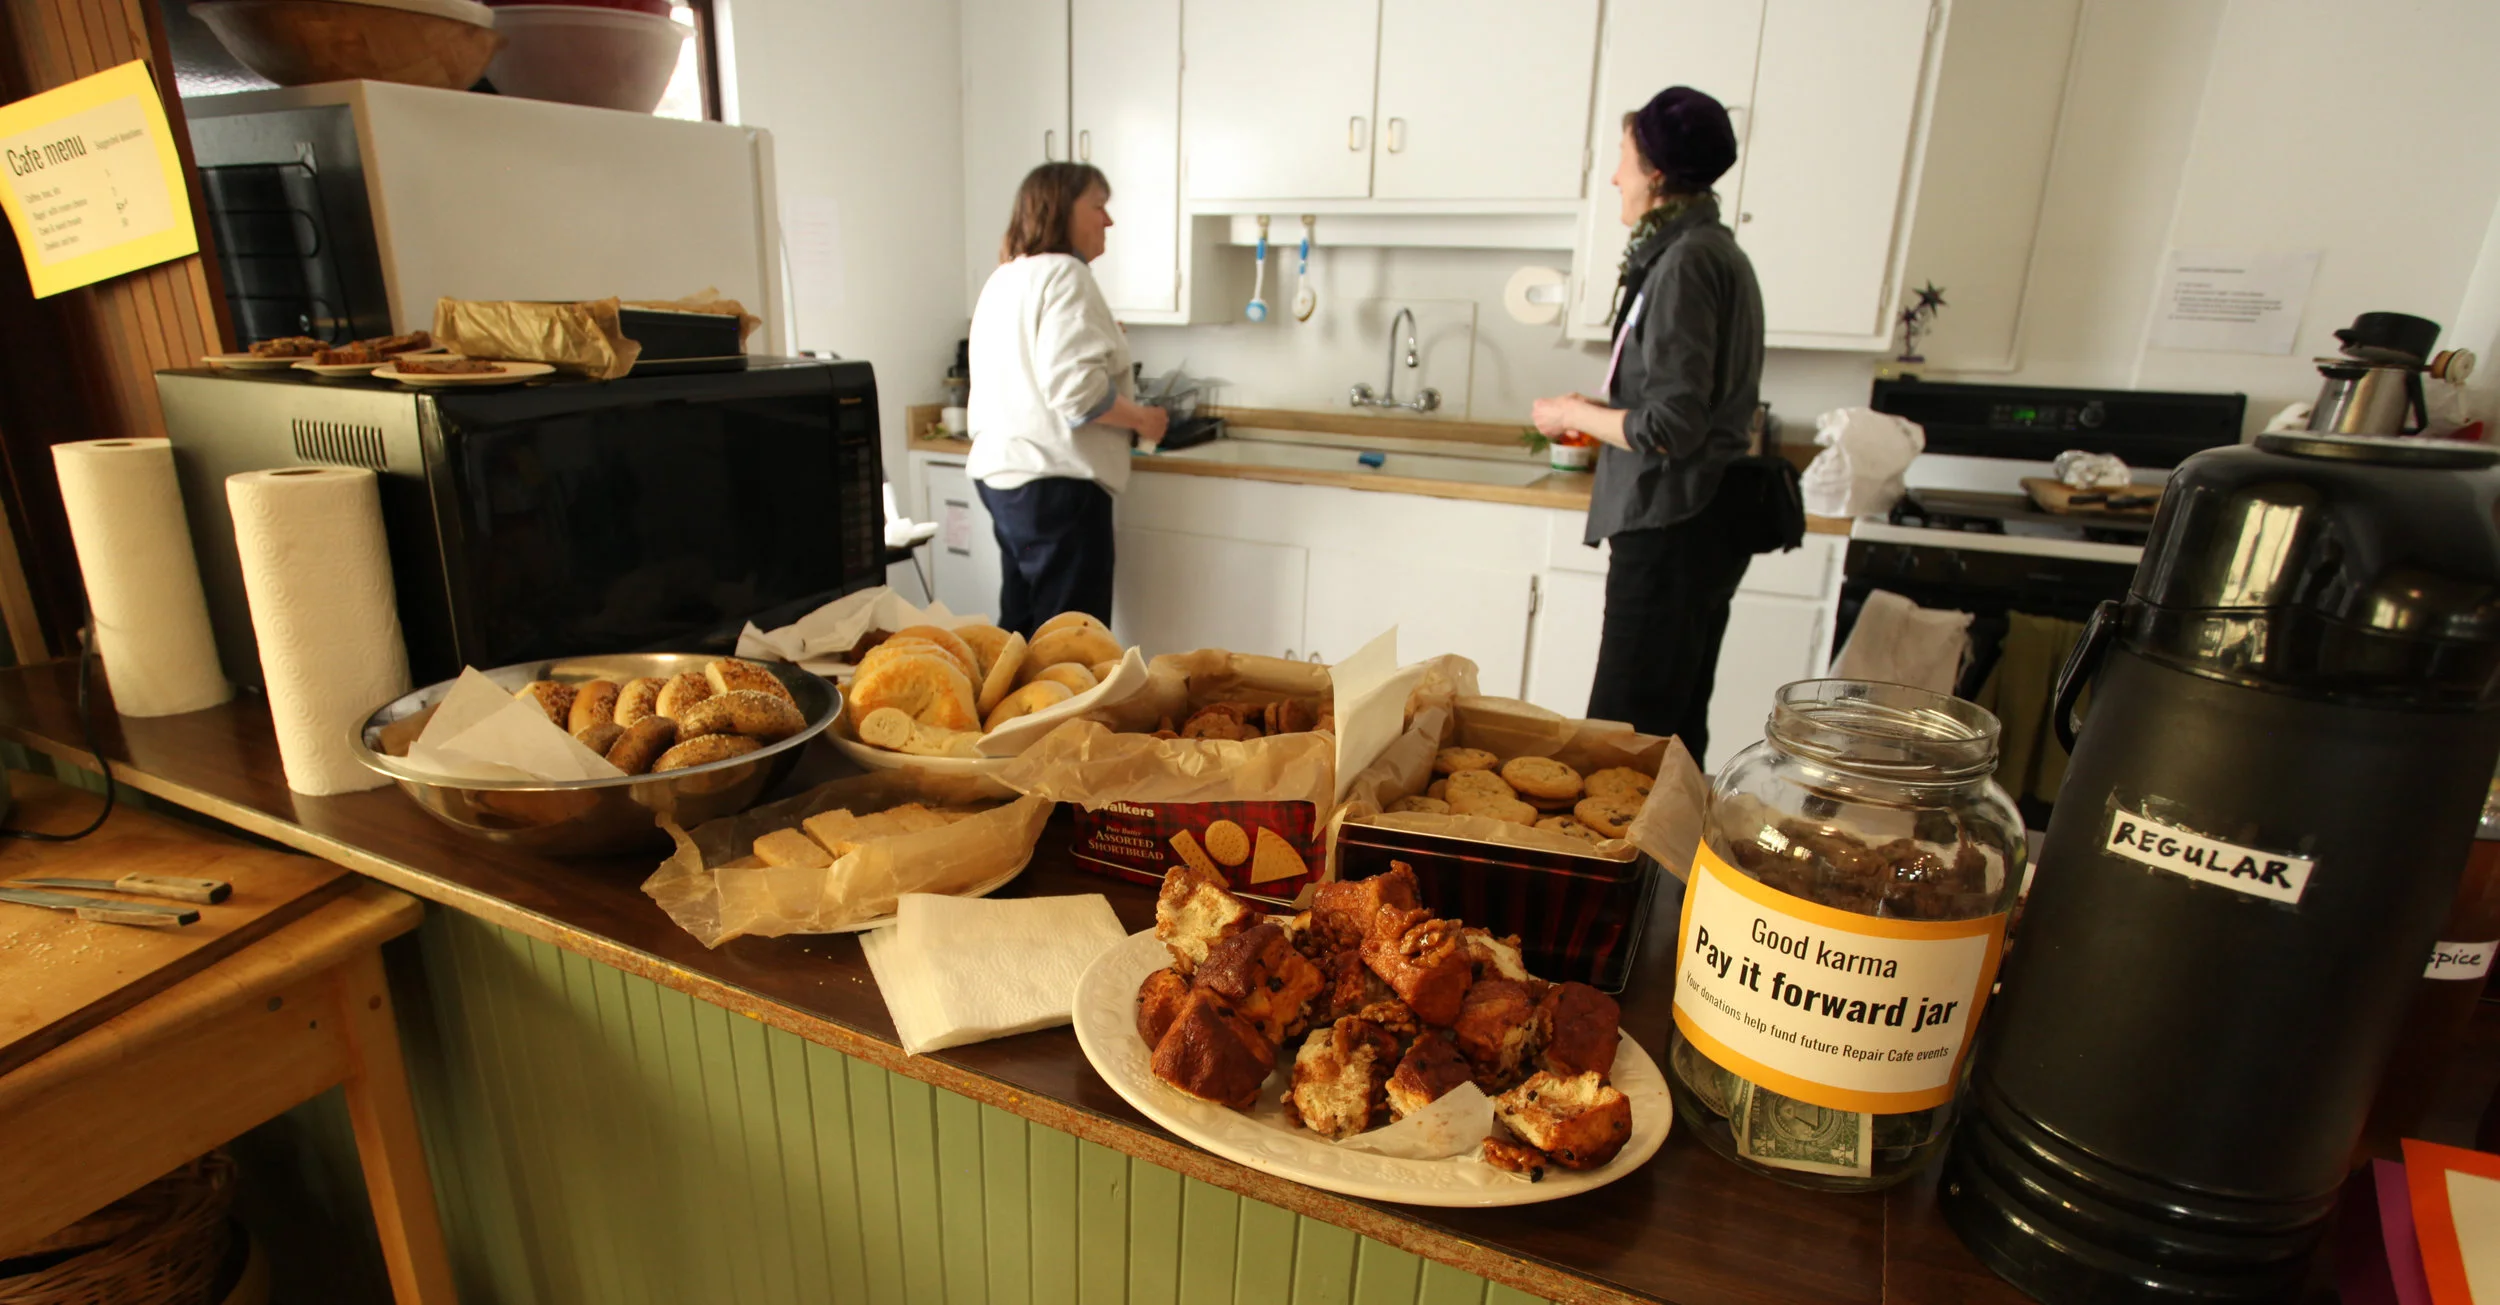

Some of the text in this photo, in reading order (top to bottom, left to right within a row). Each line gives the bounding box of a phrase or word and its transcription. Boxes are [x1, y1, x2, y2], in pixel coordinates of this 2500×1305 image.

[7, 134, 87, 177] Cafe menu
[1099, 802, 1154, 818] alkers
[2113, 821, 2292, 889] REGULAR
[1696, 925, 1958, 1033] Pay it forward jar
[1752, 918, 1898, 979] Good karma
[1686, 972, 1948, 1062] Your donations help fund future Repair Cafe events
